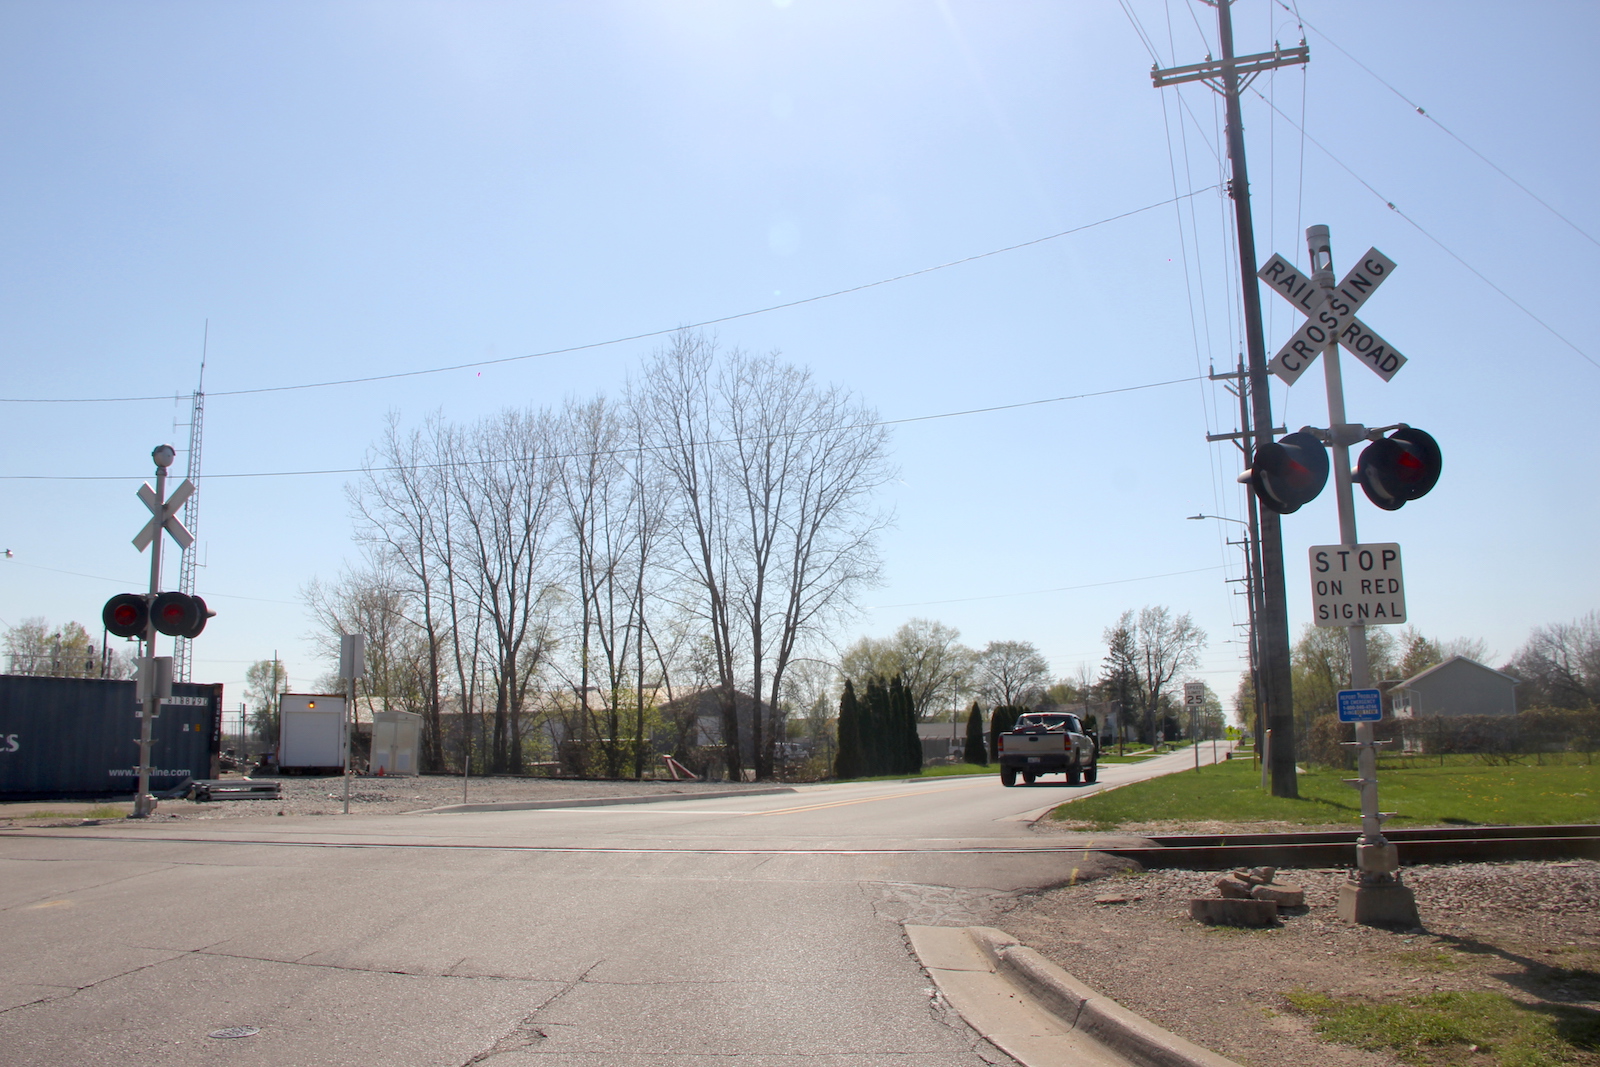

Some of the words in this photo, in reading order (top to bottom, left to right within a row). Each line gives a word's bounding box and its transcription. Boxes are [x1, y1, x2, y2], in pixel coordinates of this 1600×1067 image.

[1265, 260, 1315, 310] RAIL
[1341, 322, 1399, 373] ROAD
[1280, 259, 1384, 372] CROSSING
[1315, 550, 1396, 573] STOP
[1316, 580, 1343, 596] ON
[1361, 578, 1399, 594] RED
[1318, 602, 1402, 620] SIGNAL
[1187, 695, 1203, 704] 25
